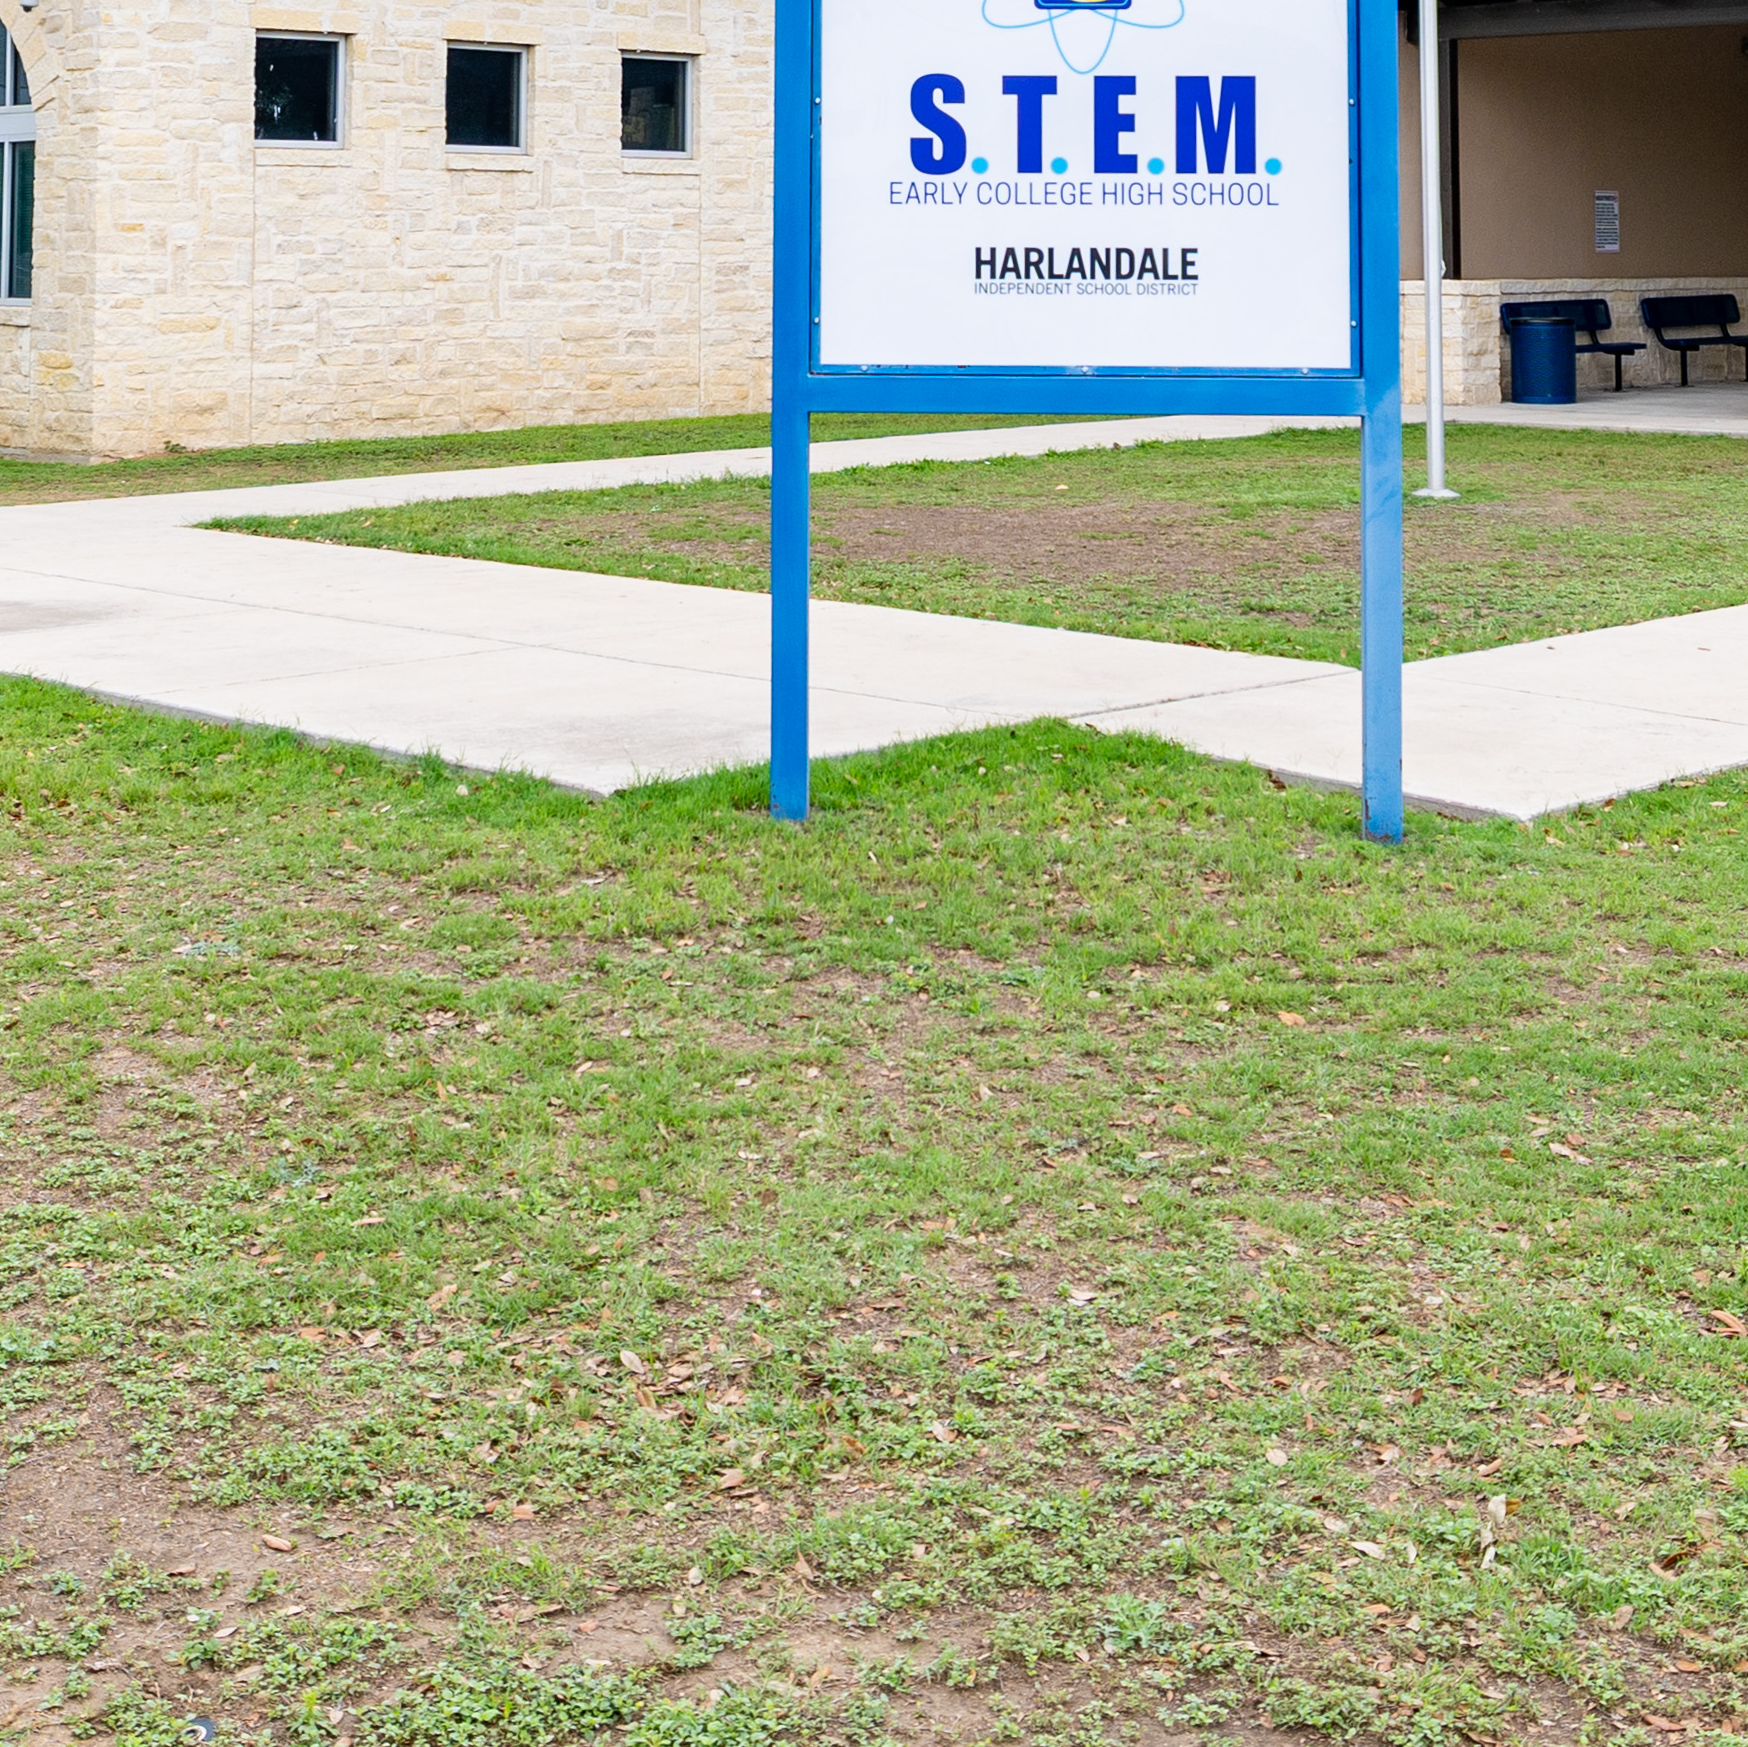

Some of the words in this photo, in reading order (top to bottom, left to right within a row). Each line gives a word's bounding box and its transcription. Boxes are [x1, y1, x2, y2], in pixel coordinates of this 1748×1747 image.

[909, 73, 1283, 176] S.T.E.M.
[889, 181, 968, 205] EARLY
[976, 181, 1093, 205] COLLEGE
[1102, 181, 1164, 205] HIGH
[1172, 181, 1280, 206] SCHOOL
[974, 247, 1199, 280] HARLANDALE
[974, 283, 1072, 295] INDEPENDENT
[1076, 283, 1133, 295] SCHOOL
[1137, 283, 1198, 296] DISTRICT
